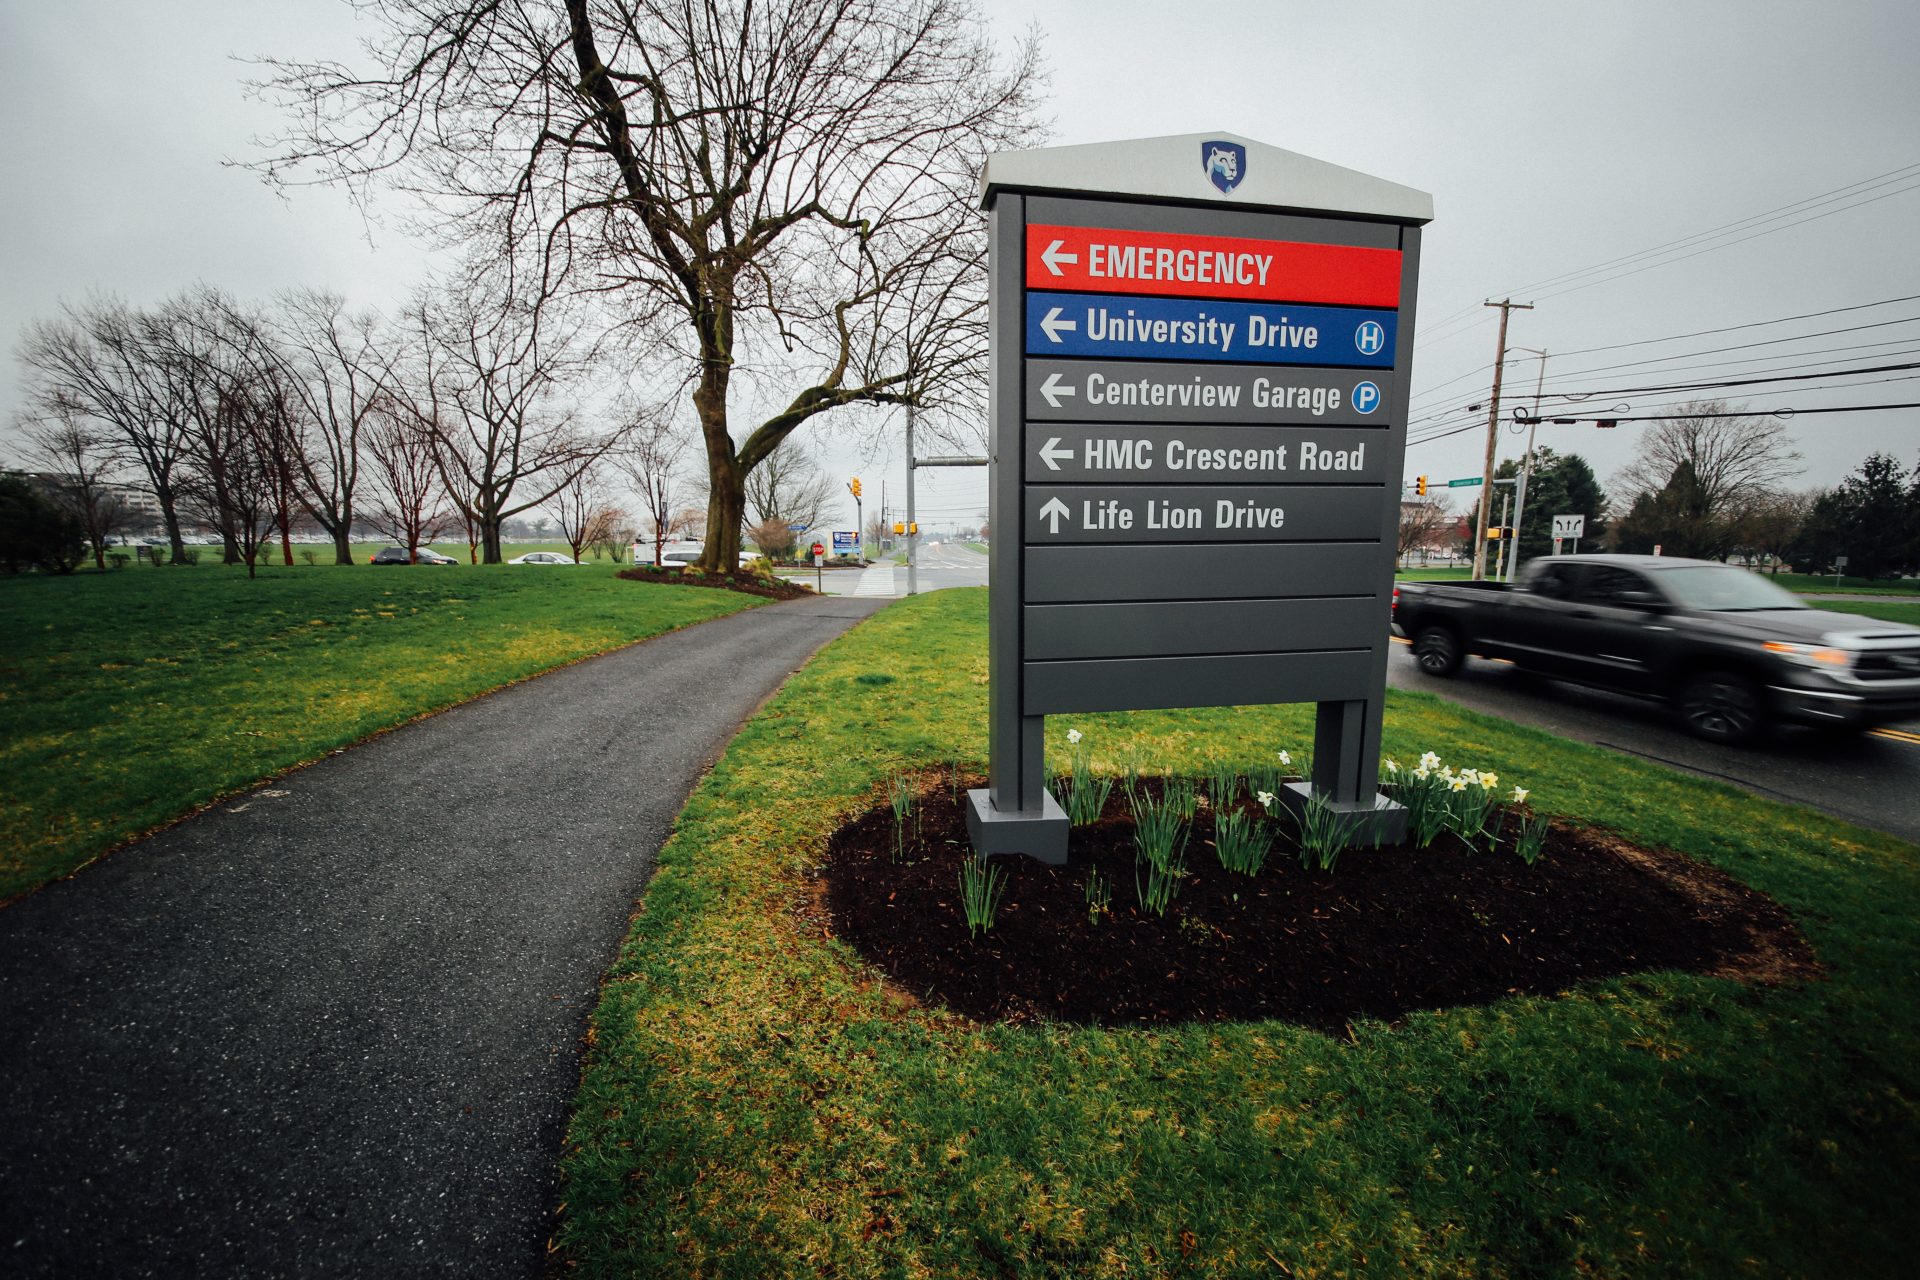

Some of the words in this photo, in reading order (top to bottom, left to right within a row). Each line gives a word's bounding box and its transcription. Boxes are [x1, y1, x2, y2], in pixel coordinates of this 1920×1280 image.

[1088, 243, 1274, 287] EMERGENCY
[1087, 307, 1236, 352] University
[1248, 315, 1318, 349] Drive
[1361, 326, 1378, 351] H
[1086, 373, 1241, 409] Centerview
[1252, 377, 1341, 416] Garage
[1359, 386, 1375, 408] P
[1084, 439, 1153, 471] HMC
[1166, 439, 1287, 471] Crescent
[1299, 441, 1365, 472] Road
[1083, 500, 1134, 531] Life
[1147, 500, 1202, 529] Lion
[1215, 499, 1285, 529] Drive
